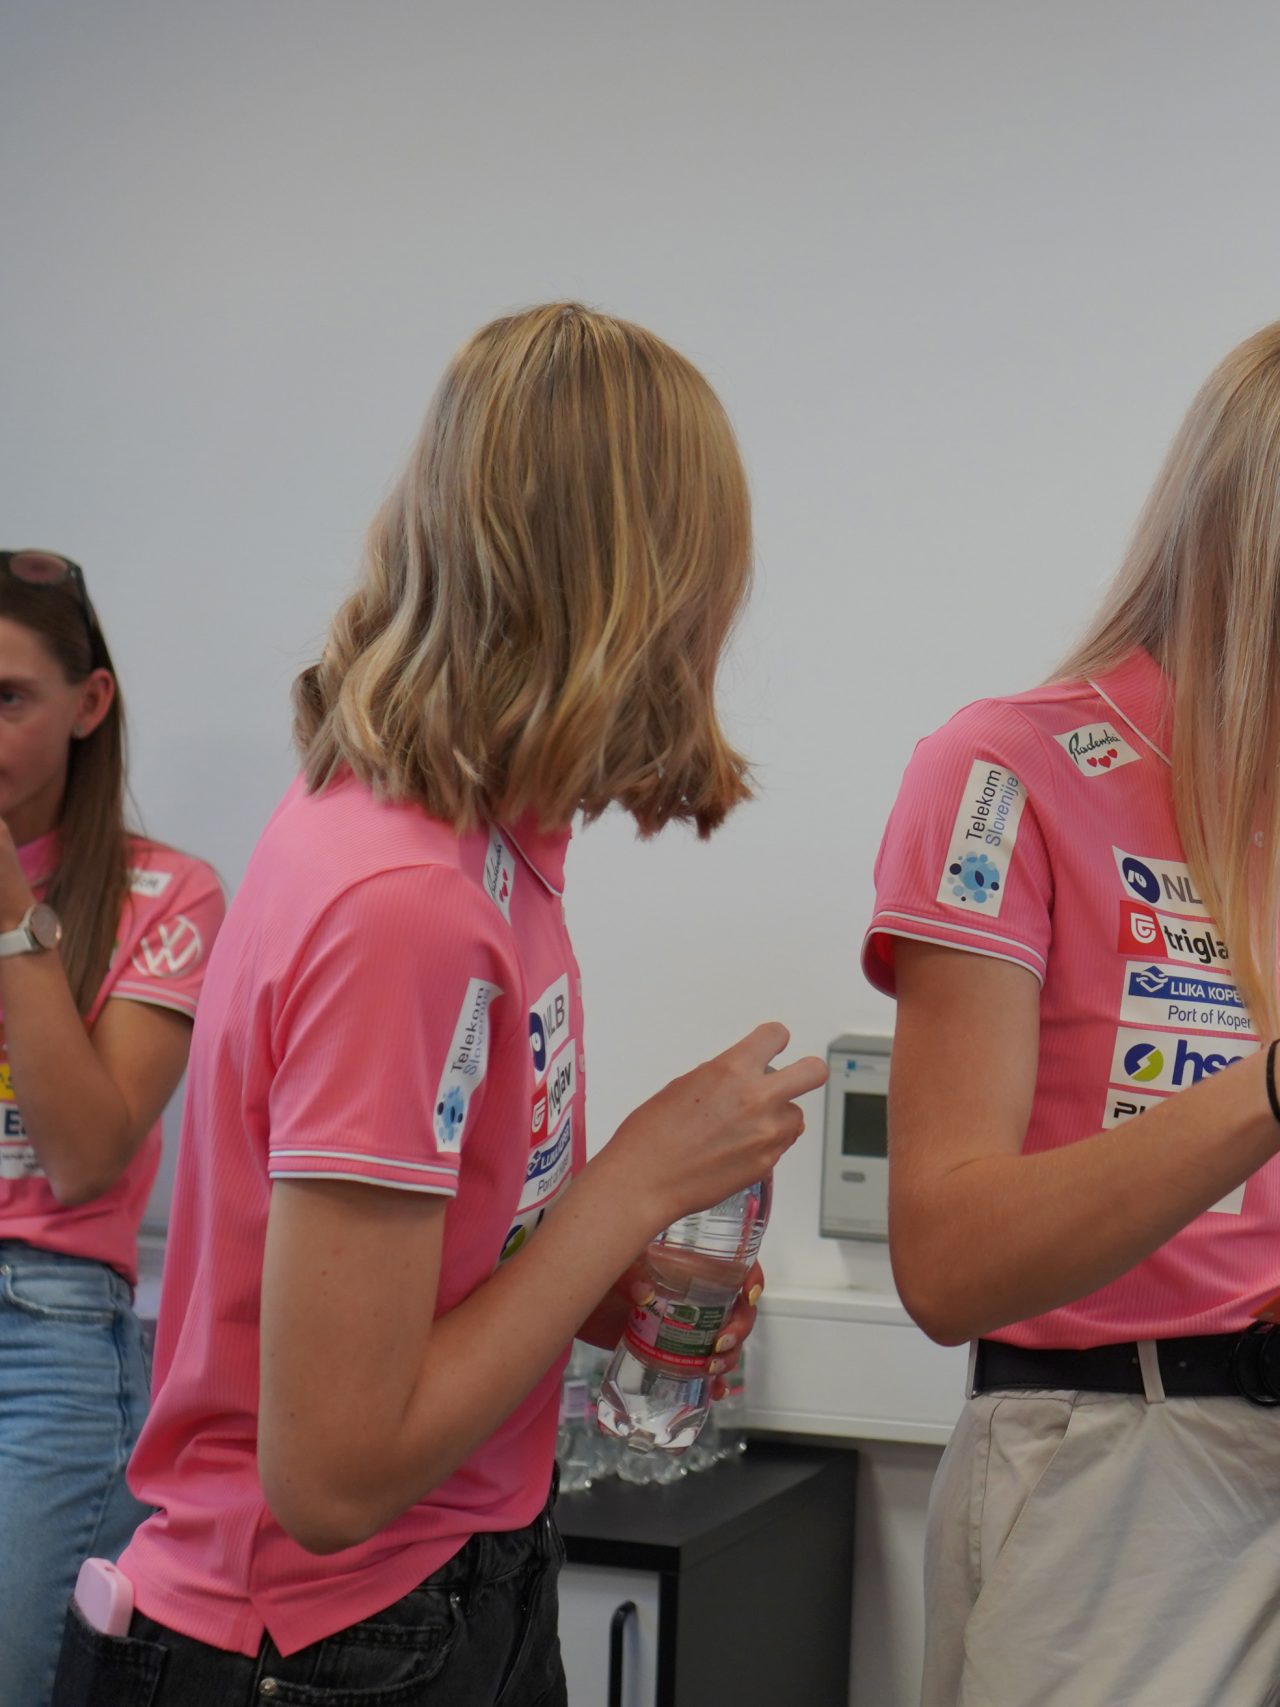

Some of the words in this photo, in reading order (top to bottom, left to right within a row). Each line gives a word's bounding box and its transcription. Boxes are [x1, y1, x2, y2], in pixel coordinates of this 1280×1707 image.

[966, 769, 1002, 840] Telekom
[985, 776, 1019, 847] Slovenije
[1161, 873, 1204, 905] NL
[1164, 925, 1230, 964] trigla
[1170, 981, 1206, 998] LUKA
[1208, 988, 1243, 1003] KOPE
[1168, 1005, 1196, 1022] Port
[1200, 1009, 1214, 1024] of
[1217, 1010, 1251, 1031] Koper
[1171, 1039, 1245, 1087] hs
